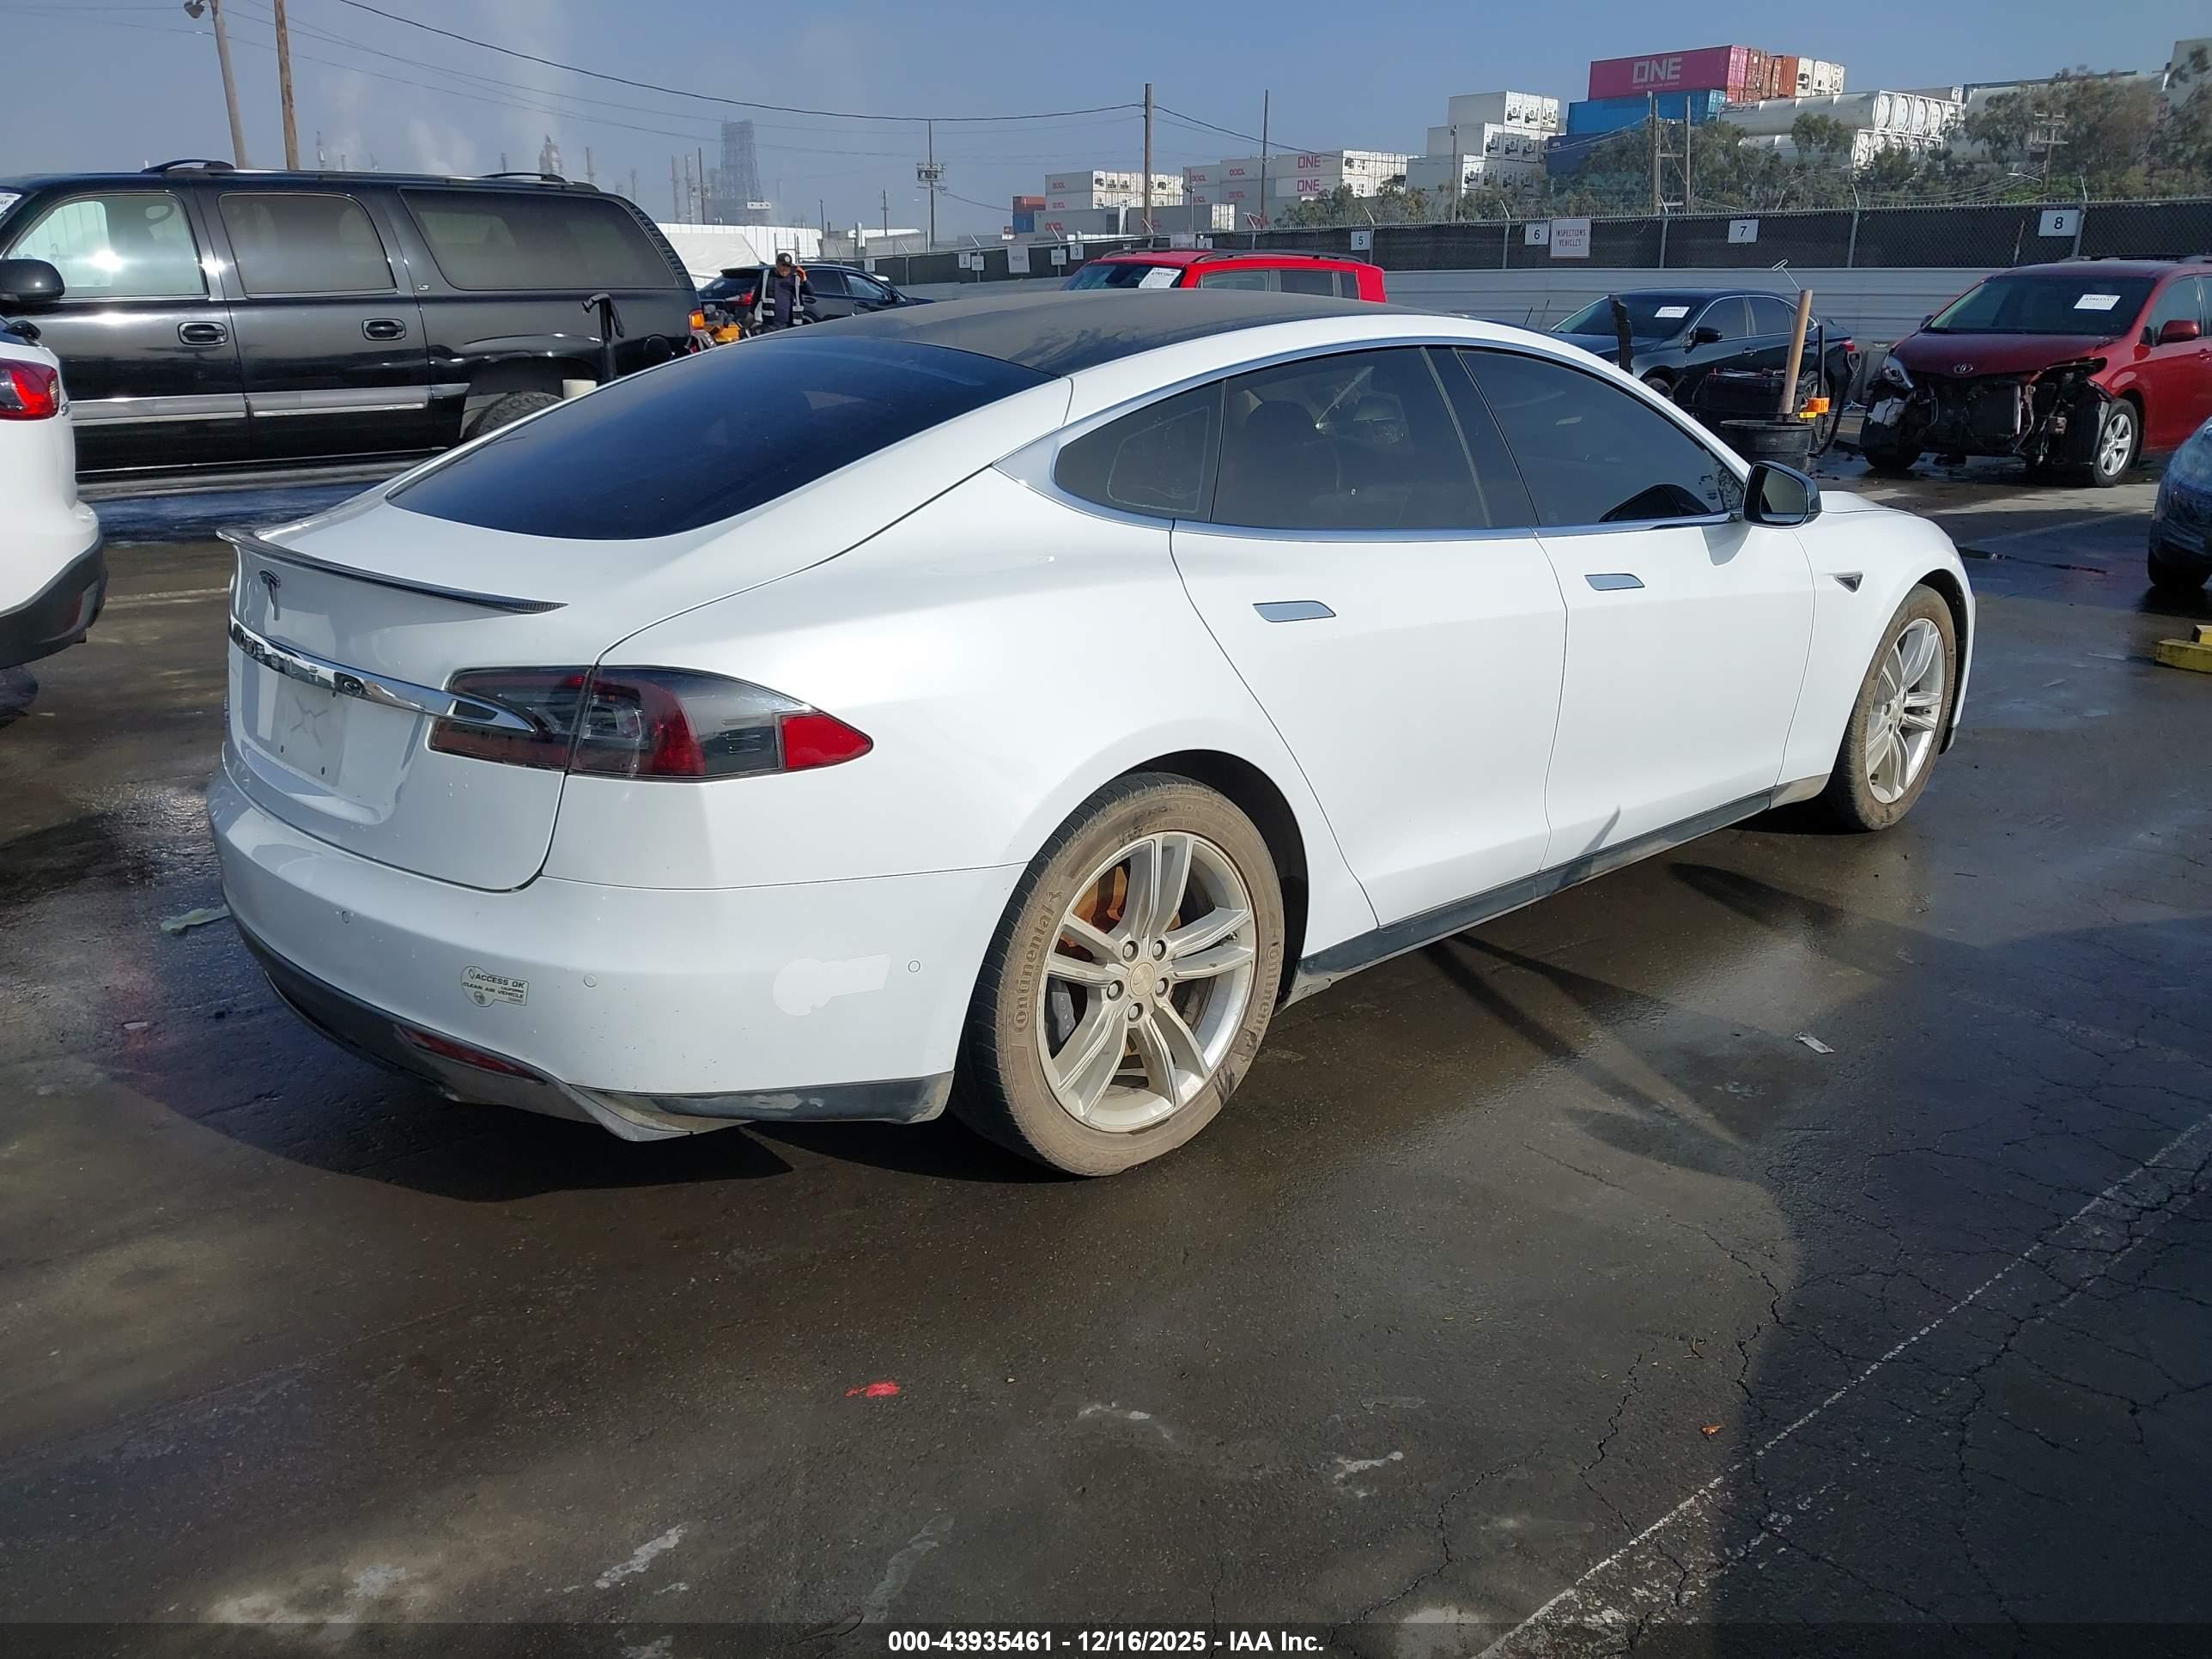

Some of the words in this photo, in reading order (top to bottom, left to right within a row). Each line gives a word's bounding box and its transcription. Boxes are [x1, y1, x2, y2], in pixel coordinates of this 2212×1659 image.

[1632, 57, 1682, 83] ONE
[1297, 155, 1322, 169] ONE
[1297, 179, 1321, 192] ONE
[2053, 216, 2063, 229] 8
[1534, 228, 1540, 240] 6
[1740, 225, 1747, 237] 7
[1358, 235, 1364, 246] 5
[1074, 247, 1079, 256] 3
[475, 974, 509, 986] ACCESS
[463, 981, 483, 990] CLEAN
[497, 989, 524, 998] VEHICLE
